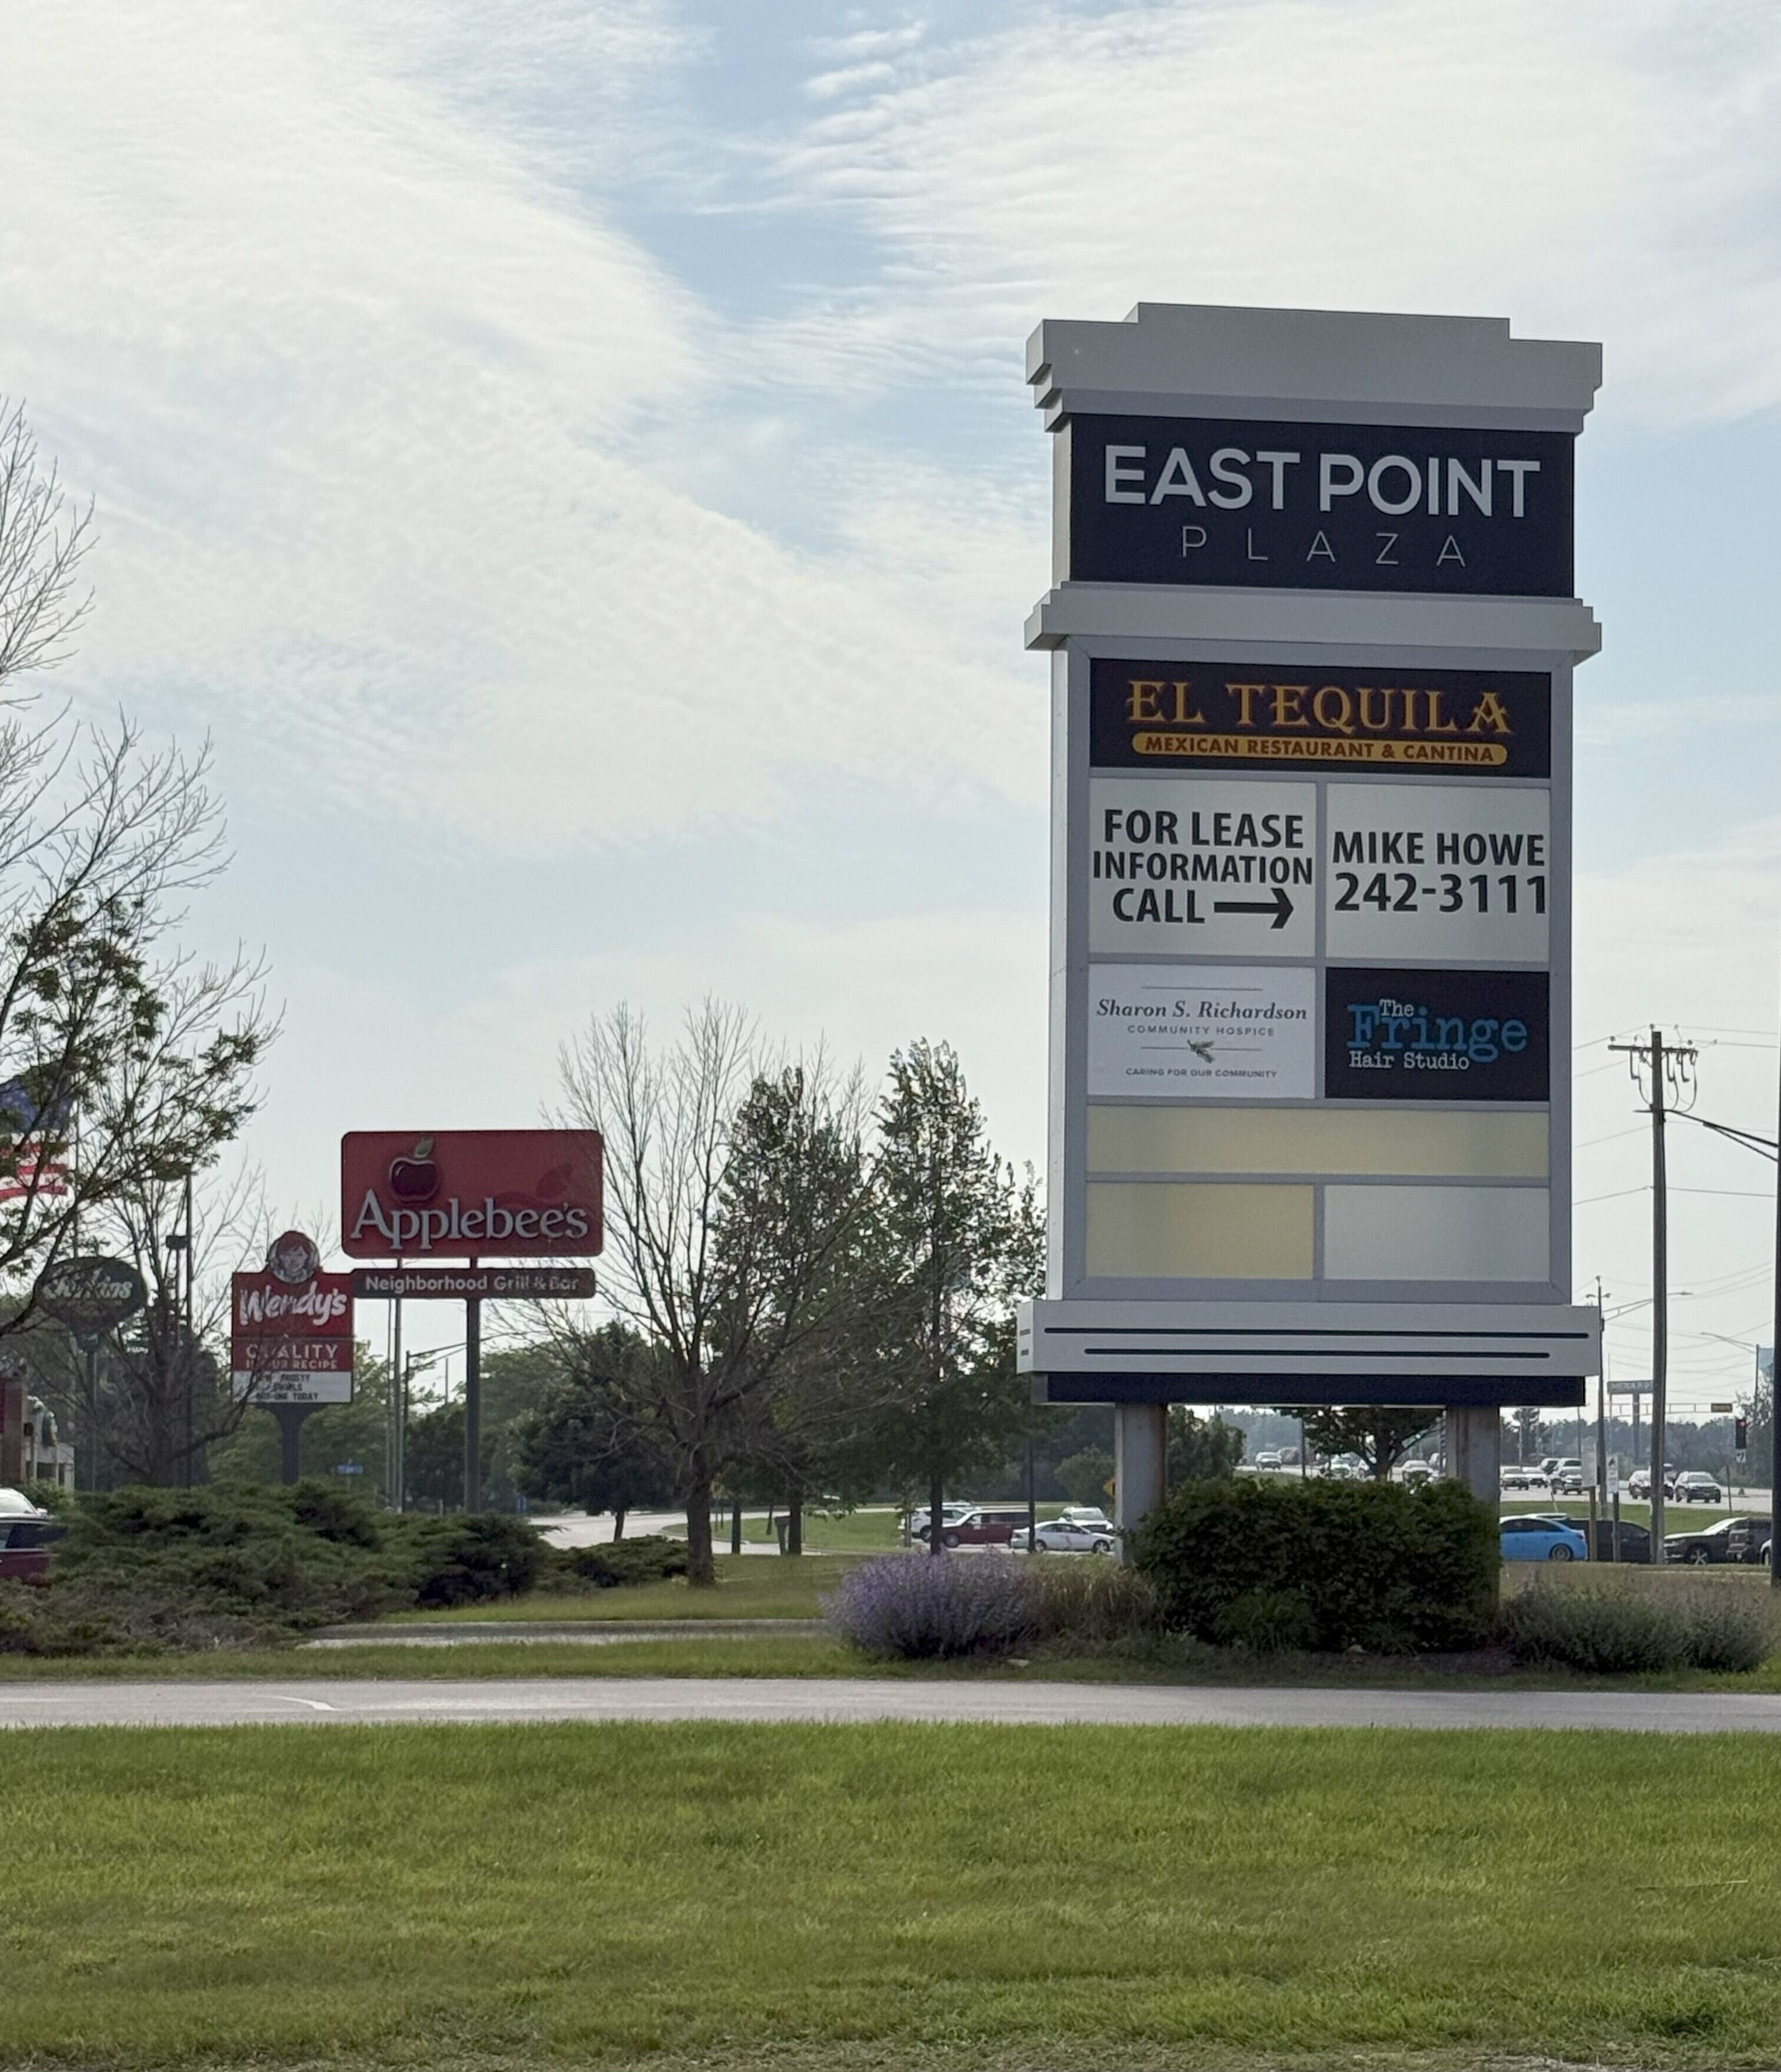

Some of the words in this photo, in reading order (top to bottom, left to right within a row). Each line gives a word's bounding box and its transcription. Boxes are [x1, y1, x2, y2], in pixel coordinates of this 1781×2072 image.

[1104, 444, 1300, 510] EAST
[1320, 452, 1541, 518] POINT
[1181, 525, 1466, 568] PLAZA
[1126, 680, 1205, 724] EL
[1225, 683, 1514, 734] TEQUILA
[1145, 736, 1238, 754] MEXICAN
[1247, 739, 1374, 759] RESTAURANT
[1382, 744, 1396, 758] &
[1403, 744, 1494, 762] CANTINA
[1104, 809, 1178, 845] FOR
[1191, 811, 1303, 849] LEASE
[1333, 831, 1425, 865] MIKE
[1436, 833, 1545, 867] HOWE
[1093, 850, 1313, 885] INFORMATION
[1113, 888, 1205, 924] CALL
[1335, 872, 1546, 914] 242-3111
[1096, 998, 1167, 1017] Sharon
[1172, 1000, 1191, 1018] S.
[1197, 1001, 1307, 1020] Richardson
[1379, 999, 1415, 1017] The
[1127, 1025, 1210, 1034] COMMUNITY
[1216, 1027, 1274, 1037] HOSPICE
[1346, 1004, 1528, 1063] Fringe
[1125, 1068, 1164, 1076] CARING
[1349, 1050, 1395, 1069] Hair
[1403, 1052, 1470, 1070] Studio
[349, 1187, 588, 1250] Applebee's
[239, 1280, 348, 1325] Wendy's
[365, 1275, 488, 1294] Neighborhood
[493, 1276, 530, 1290] Grill
[293, 1360, 338, 1370] RECIPE
